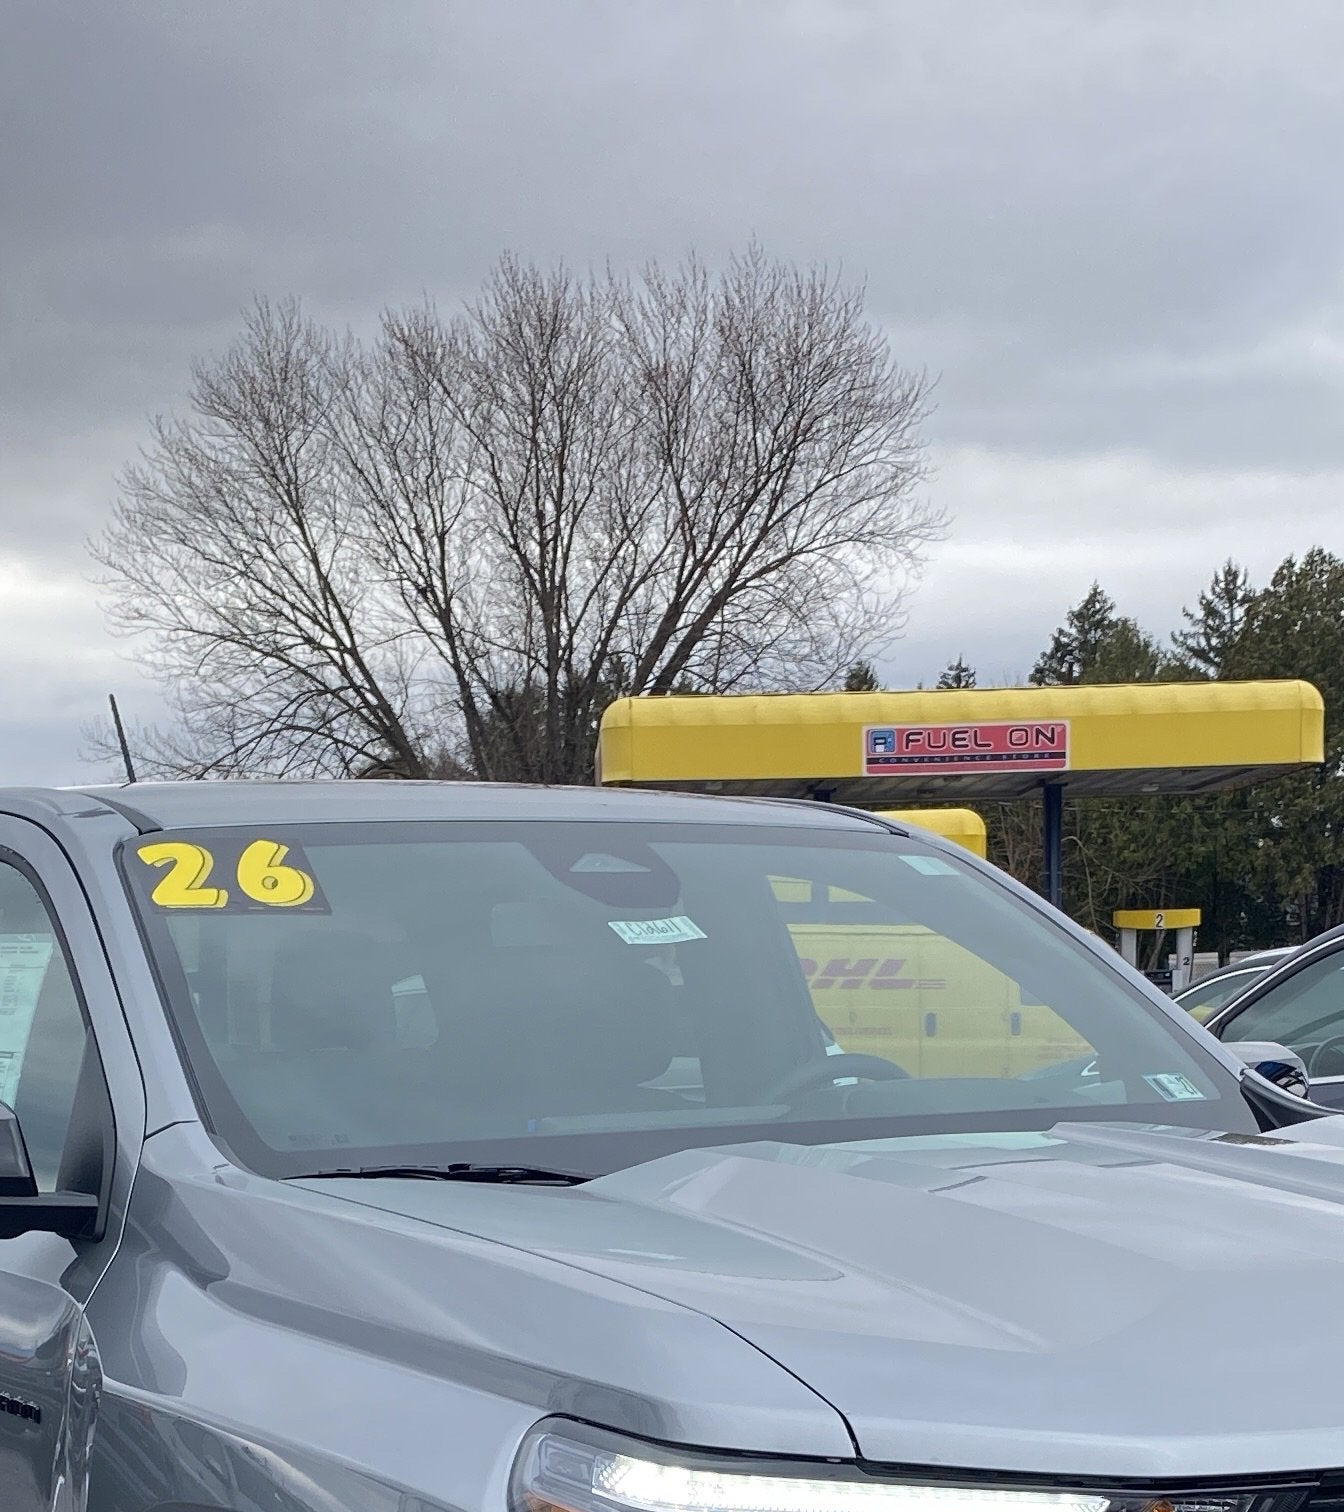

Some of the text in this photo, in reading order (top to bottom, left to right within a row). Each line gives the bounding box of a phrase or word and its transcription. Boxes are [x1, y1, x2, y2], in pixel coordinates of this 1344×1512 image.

[905, 725, 1056, 750] FUEL ON
[878, 752, 1051, 764] CONVENIENCE STORE
[1156, 913, 1164, 928] 2
[1182, 956, 1191, 966] 2
